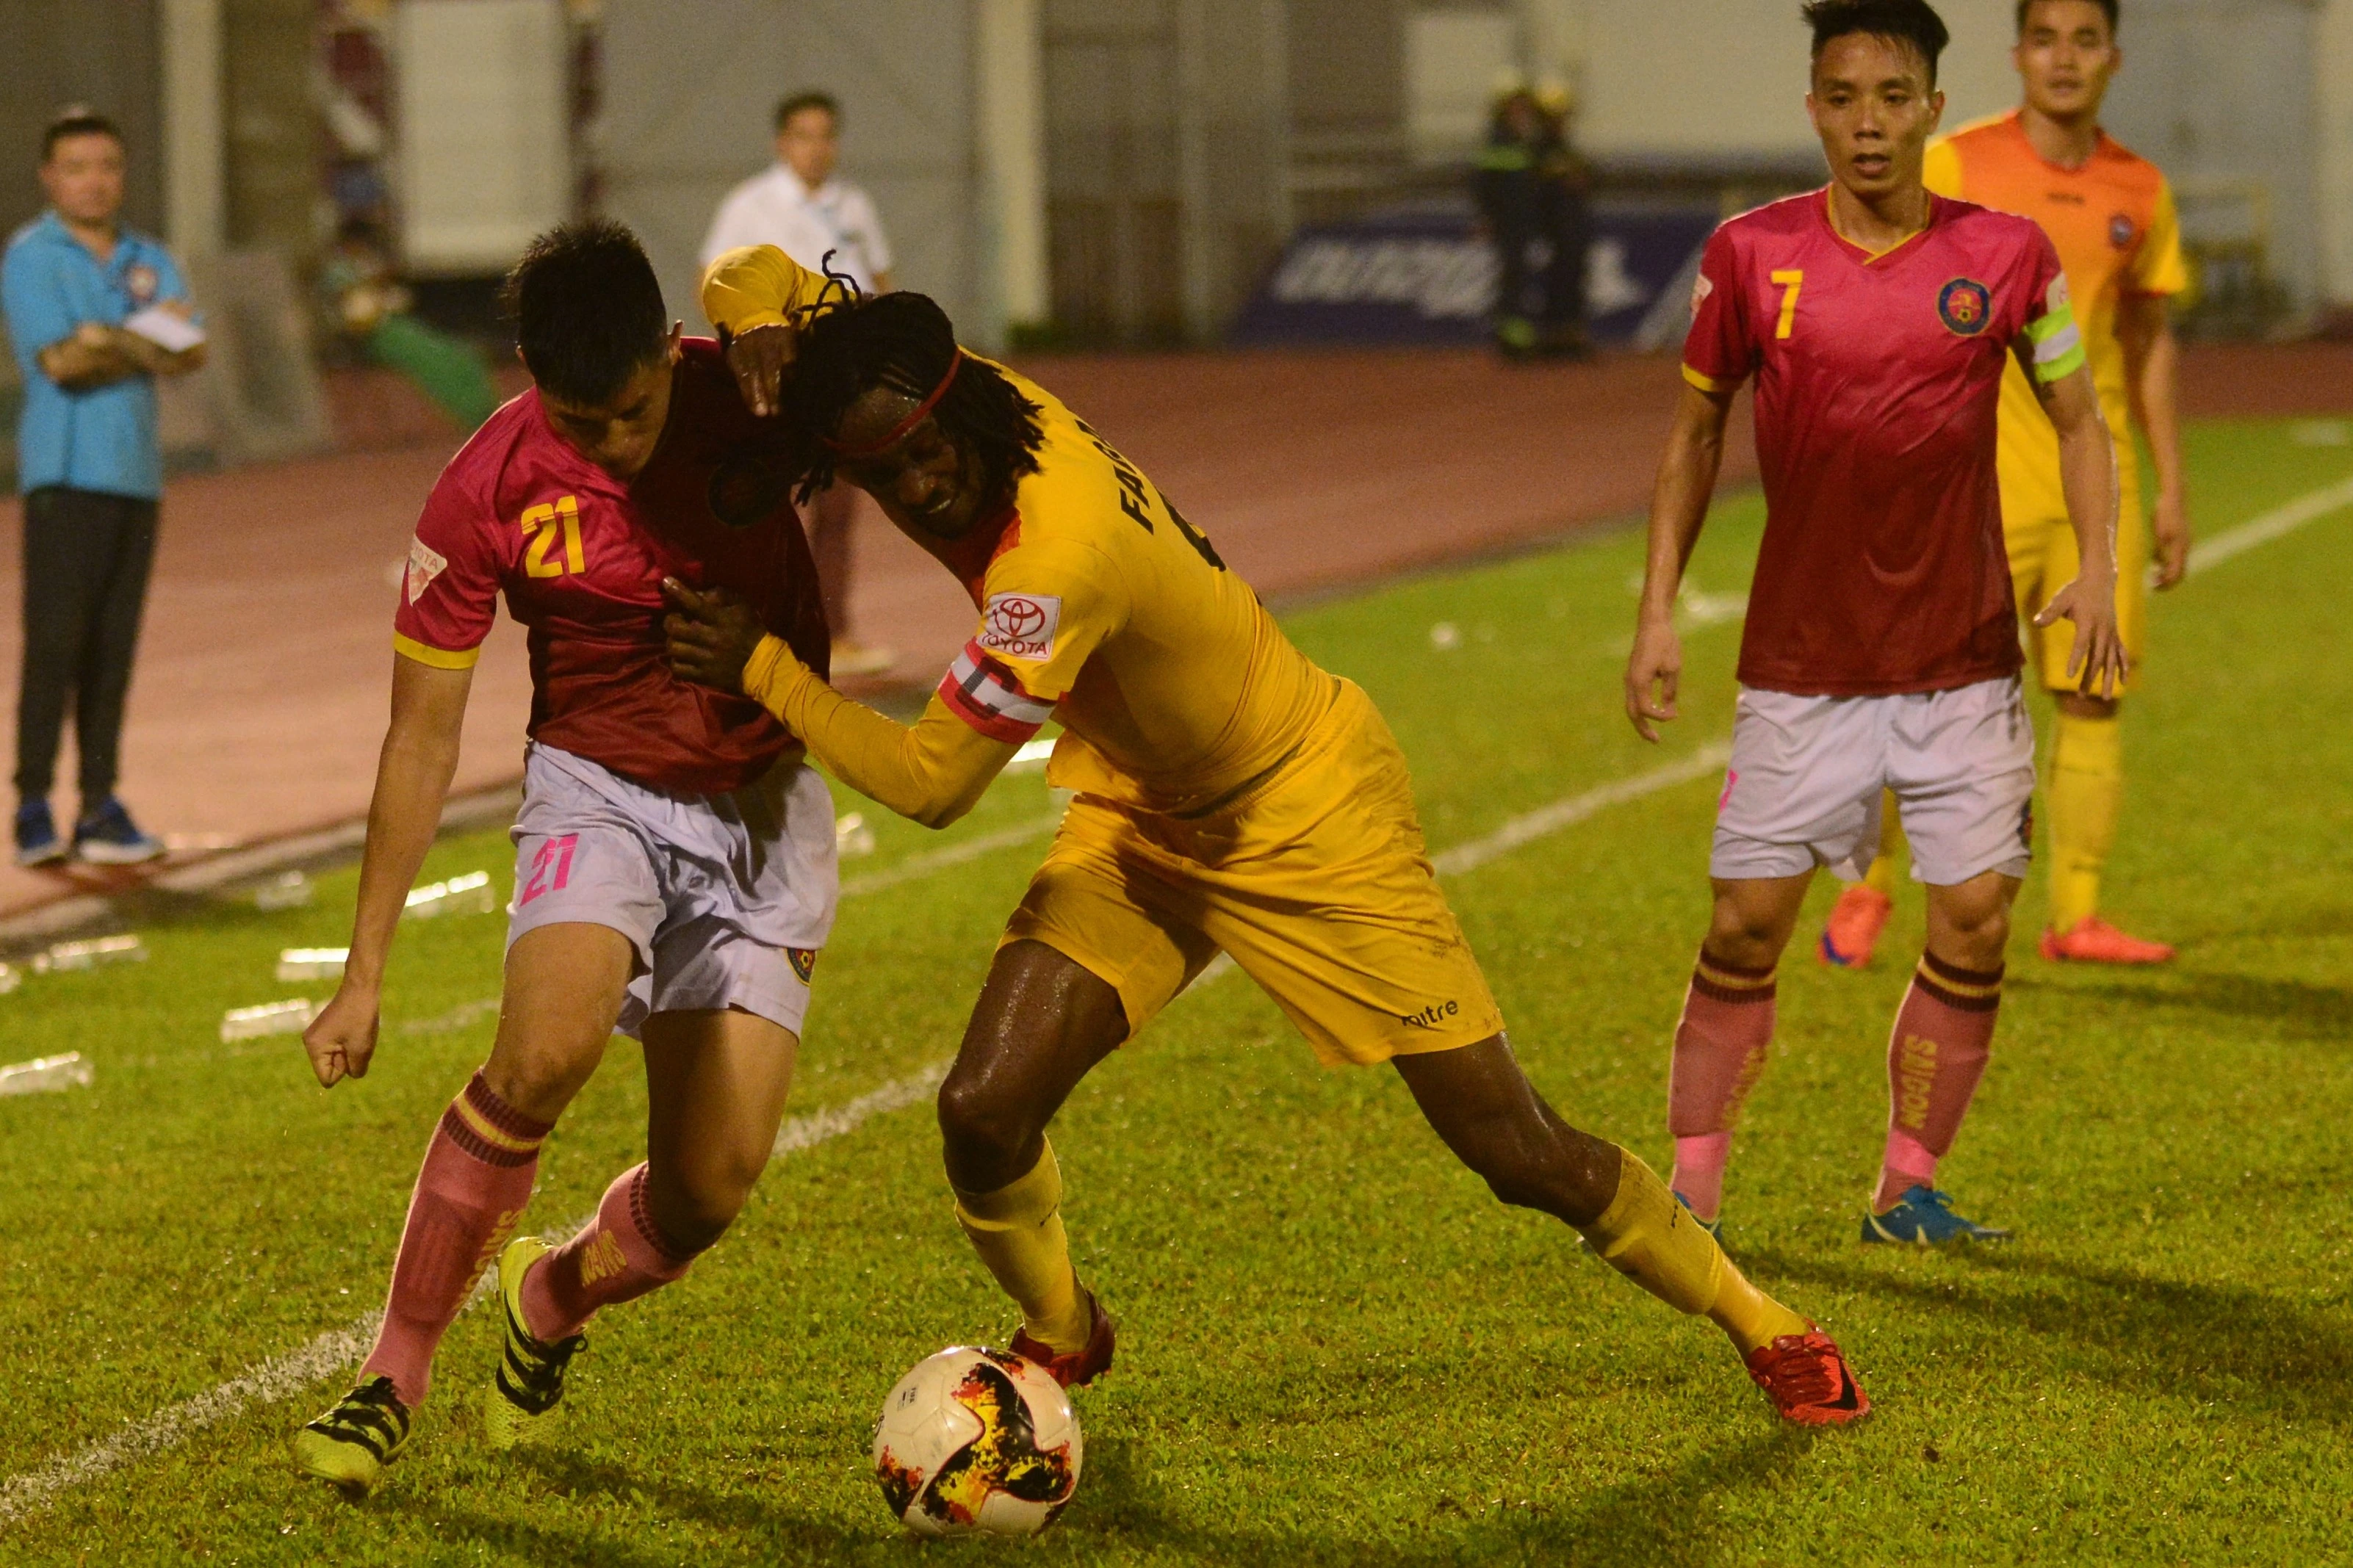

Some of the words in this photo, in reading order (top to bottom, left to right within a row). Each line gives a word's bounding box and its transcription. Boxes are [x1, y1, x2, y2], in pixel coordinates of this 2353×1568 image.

[1770, 270, 1803, 339] 7
[521, 495, 585, 578] 21
[519, 832, 579, 906] 21
[1900, 1033, 1938, 1130] SAIGON
